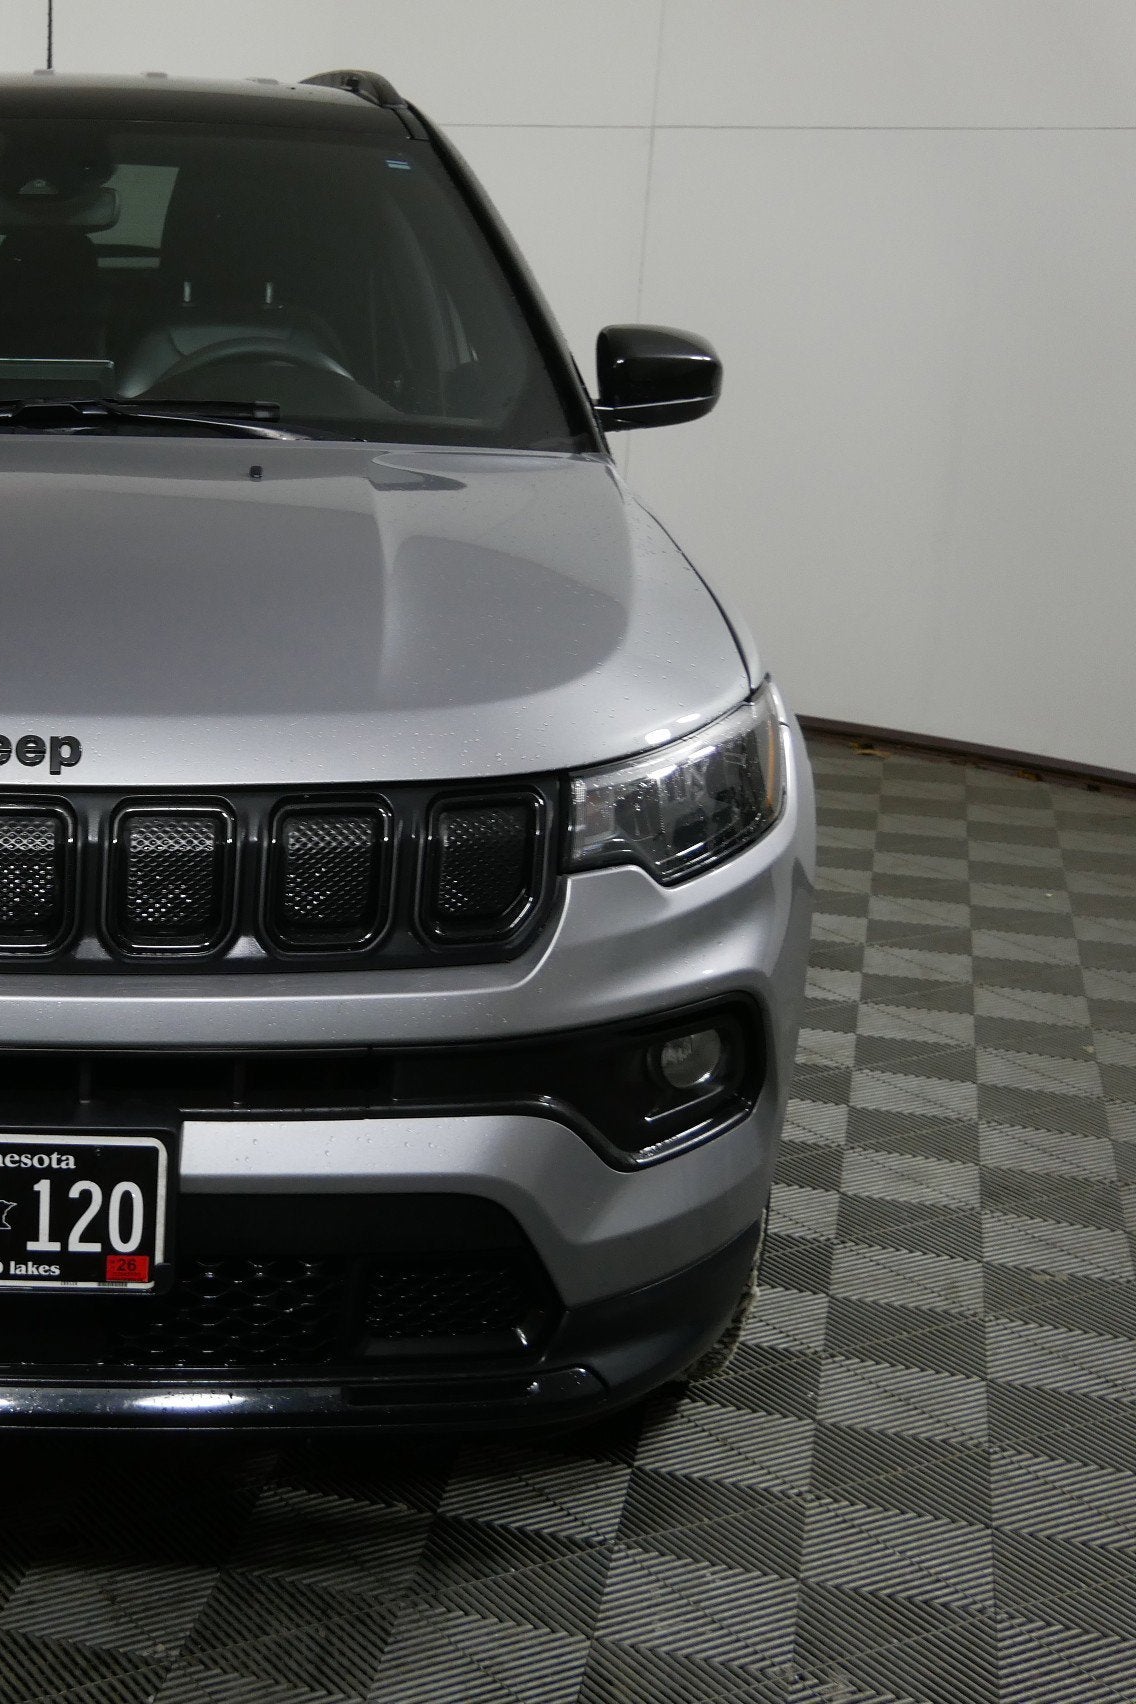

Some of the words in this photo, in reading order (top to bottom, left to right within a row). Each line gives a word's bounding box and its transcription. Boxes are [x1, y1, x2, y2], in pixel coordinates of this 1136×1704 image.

[26, 1179, 144, 1253] 120
[9, 1259, 61, 1276] lakes
[116, 1258, 137, 1272] 26
